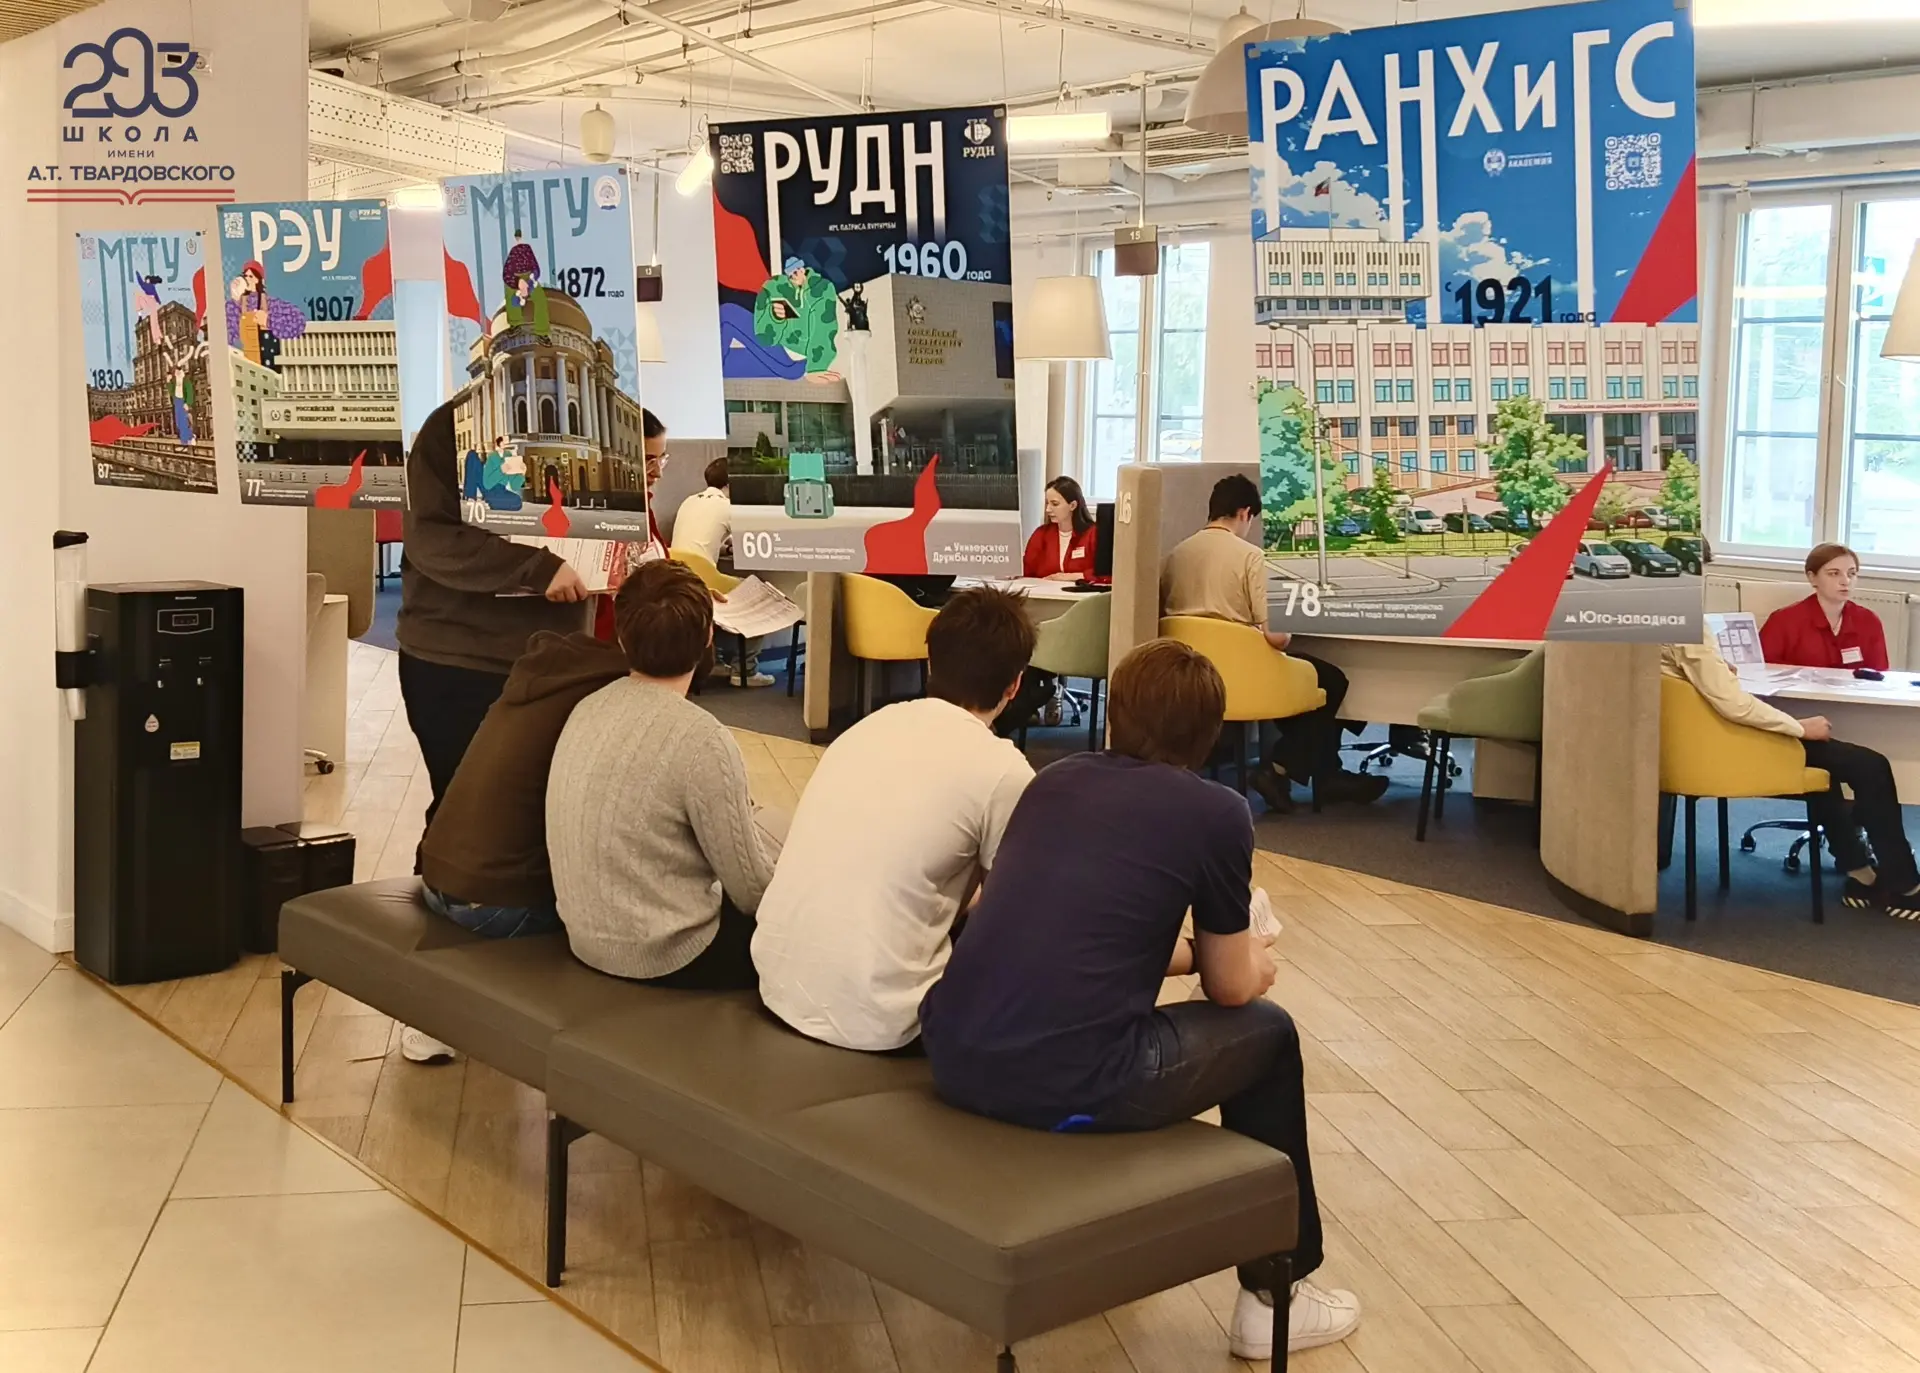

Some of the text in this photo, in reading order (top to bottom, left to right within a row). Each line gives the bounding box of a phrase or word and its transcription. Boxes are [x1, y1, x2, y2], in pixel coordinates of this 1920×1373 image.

[963, 146, 995, 157] РУДН
[1260, 21, 1677, 327] РАНХиГС
[763, 120, 946, 276] РУДН
[251, 208, 342, 274] РЭУ
[470, 177, 590, 334] МПГУ
[1130, 230, 1141, 240] 15
[884, 240, 967, 280] 1960
[967, 270, 992, 281] года
[98, 237, 180, 365] МГТУ
[557, 267, 606, 298] 1872
[608, 290, 625, 298] года
[1455, 275, 1552, 326] 1921
[1560, 312, 1597, 323] года
[307, 296, 354, 321] 1907
[92, 369, 124, 389] 1830
[1118, 491, 1132, 524] 16
